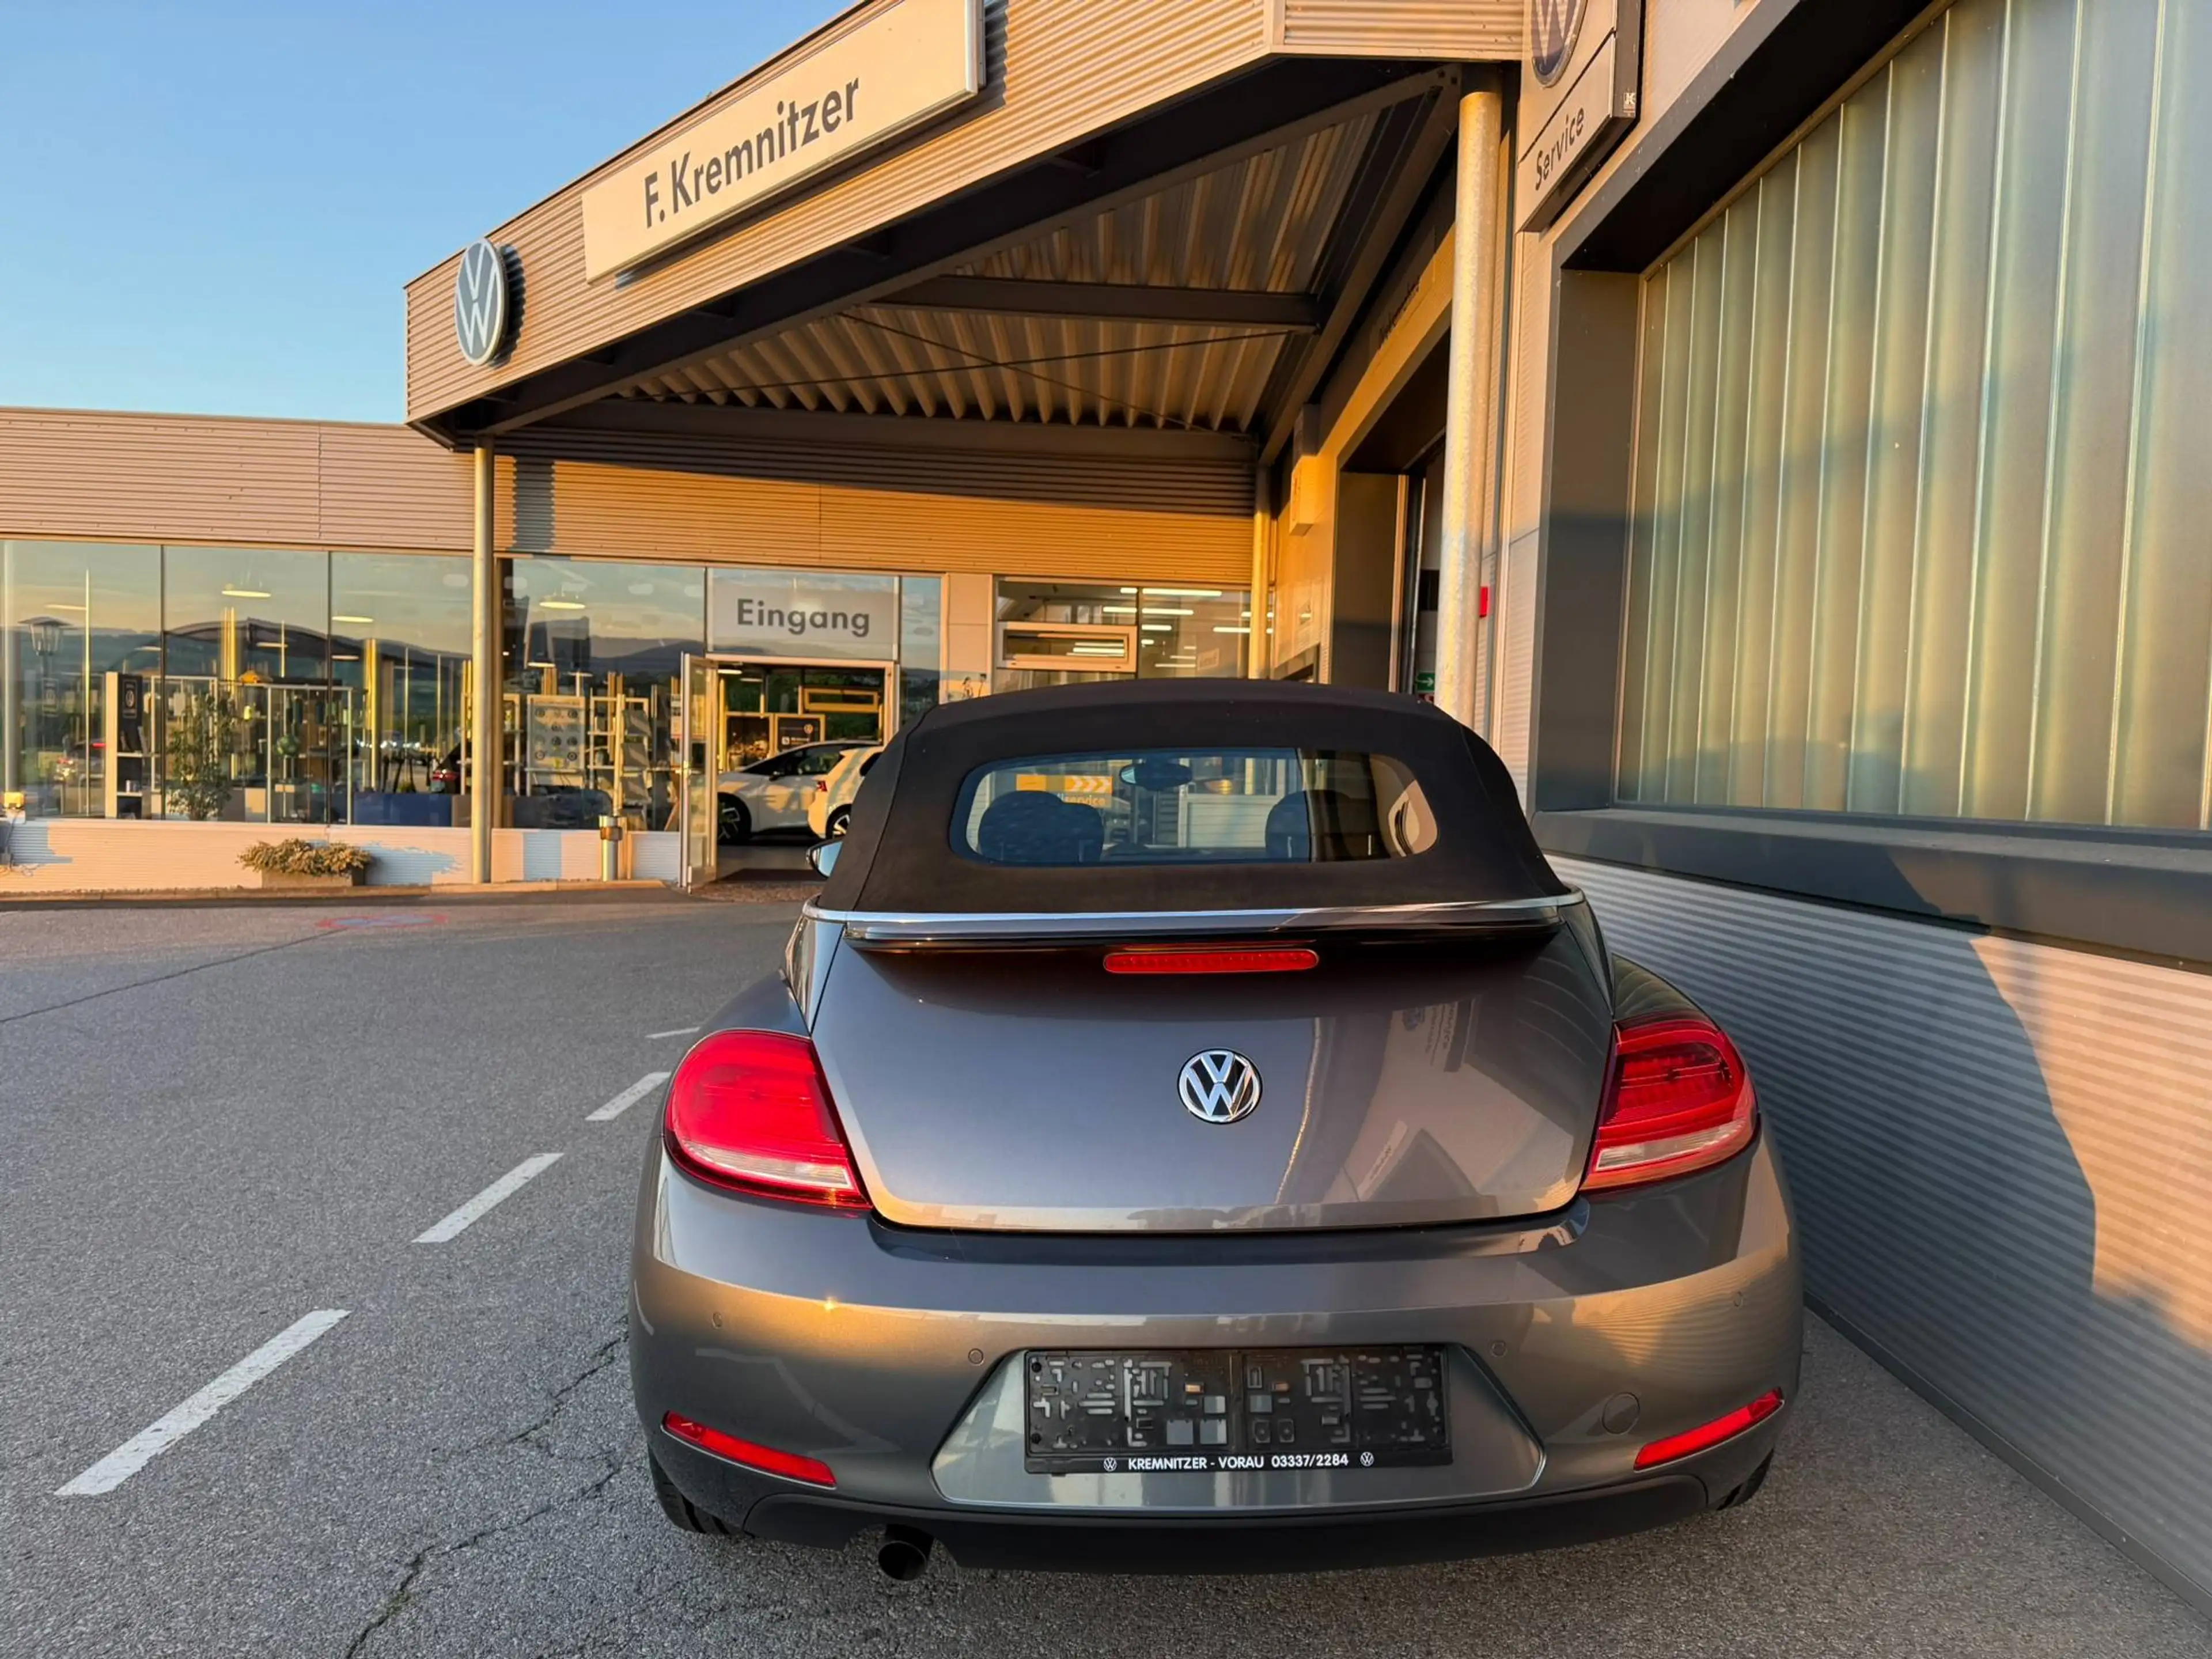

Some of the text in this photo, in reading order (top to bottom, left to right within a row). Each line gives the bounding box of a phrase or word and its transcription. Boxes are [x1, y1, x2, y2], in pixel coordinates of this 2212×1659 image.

[644, 77, 859, 229] F. Kremnitzer
[1535, 107, 1584, 191] Service
[737, 598, 870, 638] Eingang
[1128, 1457, 1207, 1470] KREMNITZER
[1219, 1456, 1264, 1469] VORAU
[1271, 1454, 1349, 1468] 03337/2284
